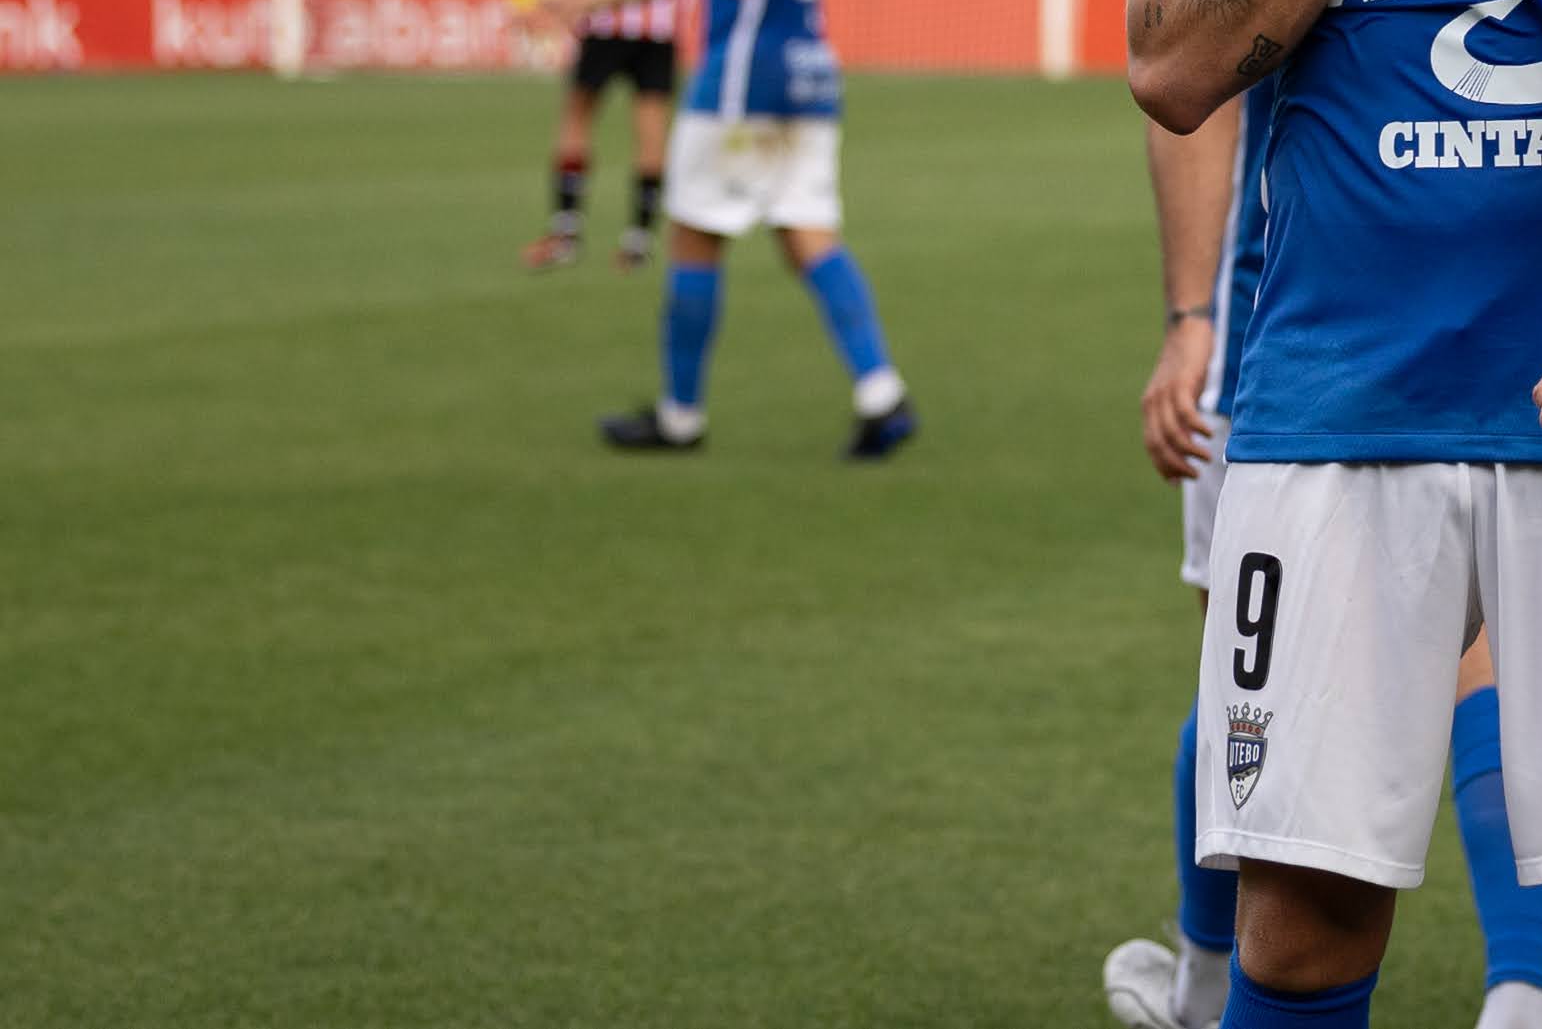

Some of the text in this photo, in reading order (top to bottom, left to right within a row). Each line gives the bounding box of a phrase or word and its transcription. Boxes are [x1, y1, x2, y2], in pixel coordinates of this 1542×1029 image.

[1233, 552, 1283, 691] 9
[1229, 741, 1260, 768] UTEBO
[1234, 783, 1245, 800] FC
